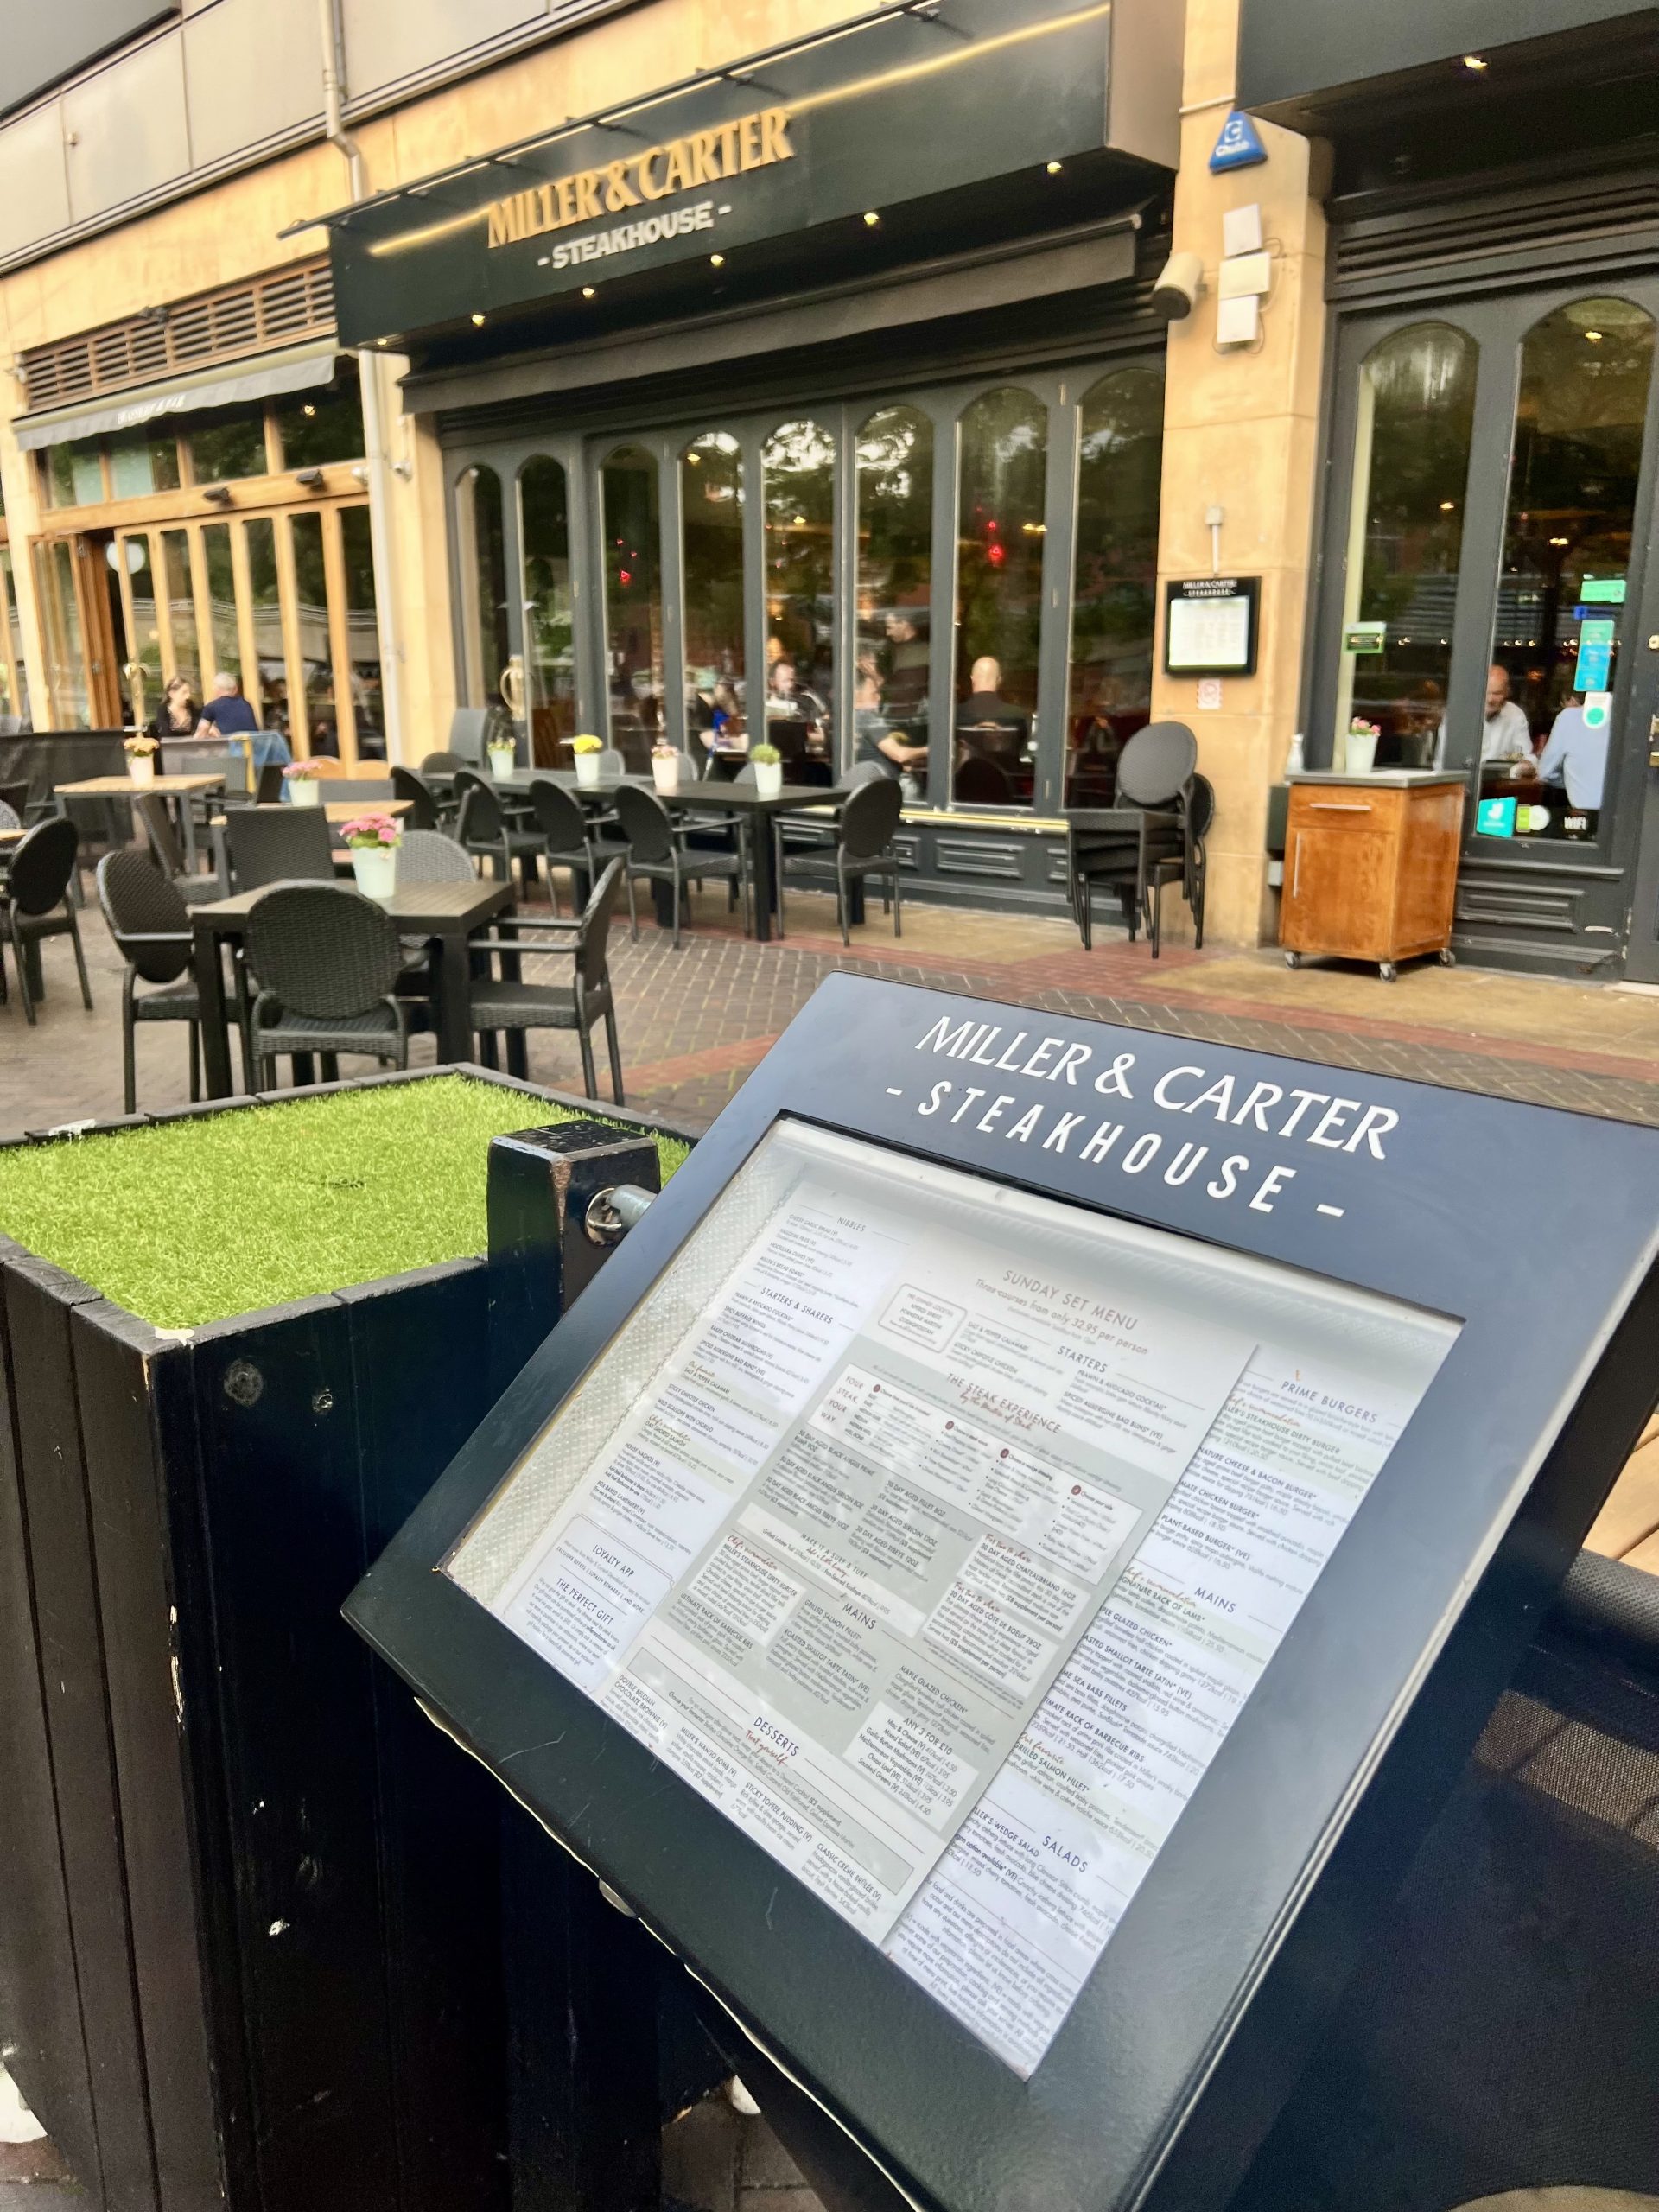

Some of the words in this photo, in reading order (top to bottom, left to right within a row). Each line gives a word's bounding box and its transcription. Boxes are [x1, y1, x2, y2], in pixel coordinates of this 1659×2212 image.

[487, 173, 604, 249] MILLER
[606, 161, 643, 212] &
[639, 109, 796, 200] CARTER
[552, 200, 715, 269] STEAKHOUSE
[914, 1015, 1094, 1085] MILLER
[1093, 1052, 1135, 1100] &
[1151, 1065, 1400, 1160] CARTER
[918, 1081, 1297, 1213] STEAKHOUSE
[760, 1287, 794, 1306] STARTERS
[800, 1305, 834, 1324] SHARERS
[973, 1278, 999, 1294] Three
[995, 1288, 1029, 1306] courses
[1028, 1300, 1052, 1315] from
[1048, 1310, 1071, 1325] only
[1070, 1318, 1099, 1334] 32.95
[1097, 1329, 1116, 1342] per
[1115, 1337, 1149, 1356] person
[1000, 1270, 1060, 1300] SUNDAY
[1060, 1293, 1090, 1312] SET
[1090, 1305, 1139, 1331] MENU
[1055, 1345, 1109, 1373] STARTERS
[844, 1376, 865, 1389] YOUR
[827, 1399, 848, 1413] YOUR
[944, 1373, 965, 1387] THE
[964, 1382, 999, 1403] STEAK
[997, 1398, 1064, 1434] EXPERIENCE
[1279, 1381, 1318, 1402] PRIME
[1319, 1395, 1378, 1423] BURGERS
[1224, 1457, 1250, 1472] CHEESE
[1256, 1471, 1285, 1487] BACON
[1198, 1489, 1229, 1506] CHICKEN
[592, 1544, 620, 1568] LOYALTY
[619, 1564, 634, 1579] APP
[555, 1578, 569, 1592] THE
[568, 1587, 597, 1613] PERFECT
[595, 1609, 613, 1626] GIFT
[841, 1602, 877, 1630] MAINS
[1152, 1592, 1171, 1605] RACK
[1193, 1586, 1236, 1613] MAINS
[1112, 1612, 1140, 1630] GLAZED
[1103, 1645, 1134, 1665] SHALLOT
[1133, 1662, 1154, 1677] TARTE
[1072, 1675, 1086, 1687] SEA
[1085, 1683, 1103, 1697] BASS
[1103, 1694, 1128, 1712] FILLETS
[753, 1716, 800, 1757] DESSERTS
[902, 1717, 919, 1732] ANY
[924, 1732, 939, 1746] FOR
[938, 1742, 953, 1756] £10
[1065, 1710, 1084, 1725] RACK
[1093, 1727, 1128, 1753] BARBECUE
[1128, 1749, 1145, 1763] RIBS
[1038, 1757, 1067, 1779] SALMON
[993, 1821, 1018, 1842] WEDGE
[1017, 1838, 1039, 1858] SALAD
[1041, 1835, 1089, 1874] SALADS
